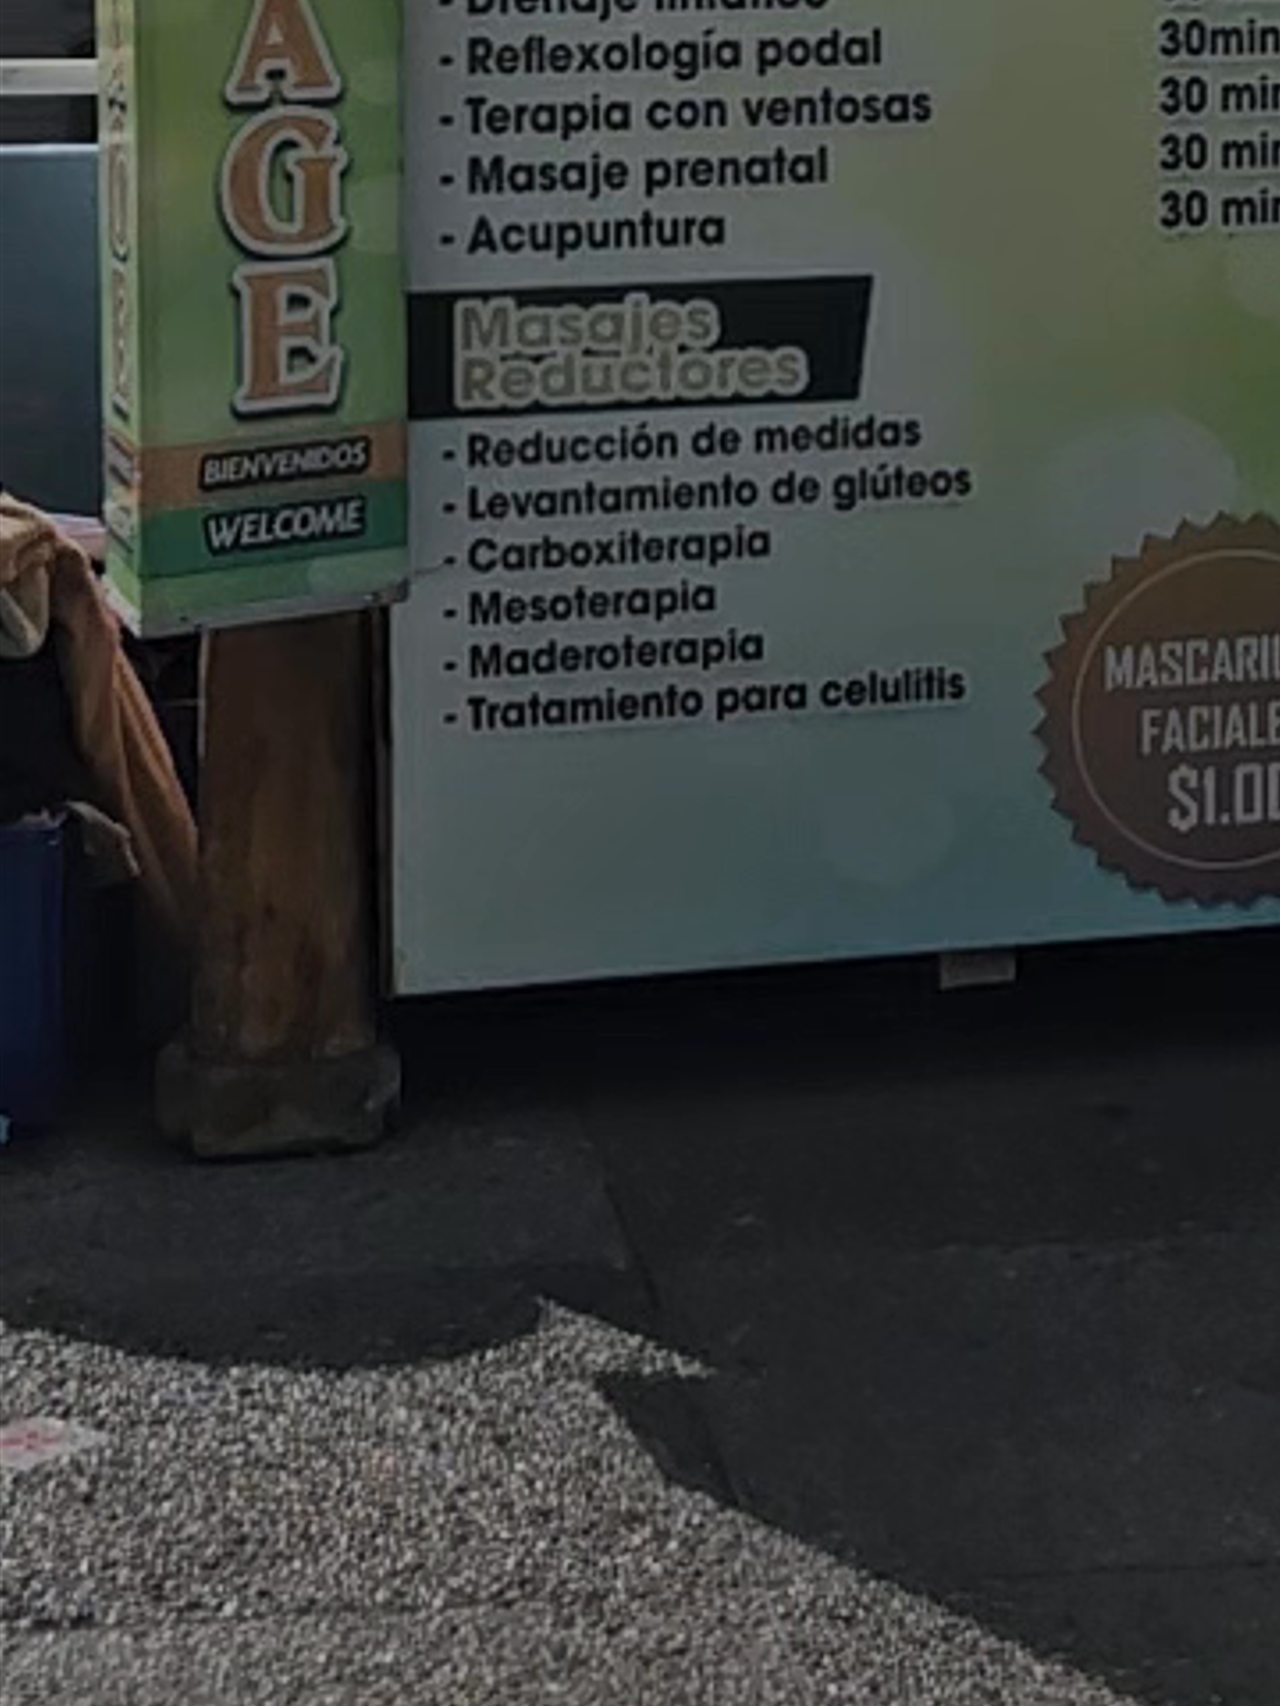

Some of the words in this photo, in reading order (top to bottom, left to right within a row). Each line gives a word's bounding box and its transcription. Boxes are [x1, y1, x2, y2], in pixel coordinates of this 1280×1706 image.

[468, 29, 741, 81] Reflexología
[757, 28, 881, 76] podal
[1160, 19, 1280, 56] 30min
[467, 210, 724, 259] Acupuntura
[1161, 191, 1207, 228] 30
[459, 297, 719, 353] Masajes
[459, 350, 807, 405] Reductores
[203, 442, 367, 483] BIENVENIDOS
[468, 422, 678, 468] Reducción
[692, 423, 741, 457] de
[755, 415, 921, 453] medidas
[468, 474, 758, 521] Levantamiento
[771, 471, 820, 504] de
[833, 464, 971, 511] glúteos
[207, 499, 363, 549] WELCOME
[468, 524, 770, 573] Carboxiterapia
[469, 580, 715, 625] Mesoterapia
[470, 628, 763, 678] Maderoterapia
[468, 685, 703, 730] Tratamiento
[717, 684, 806, 721] para
[820, 667, 965, 707] celulitis
